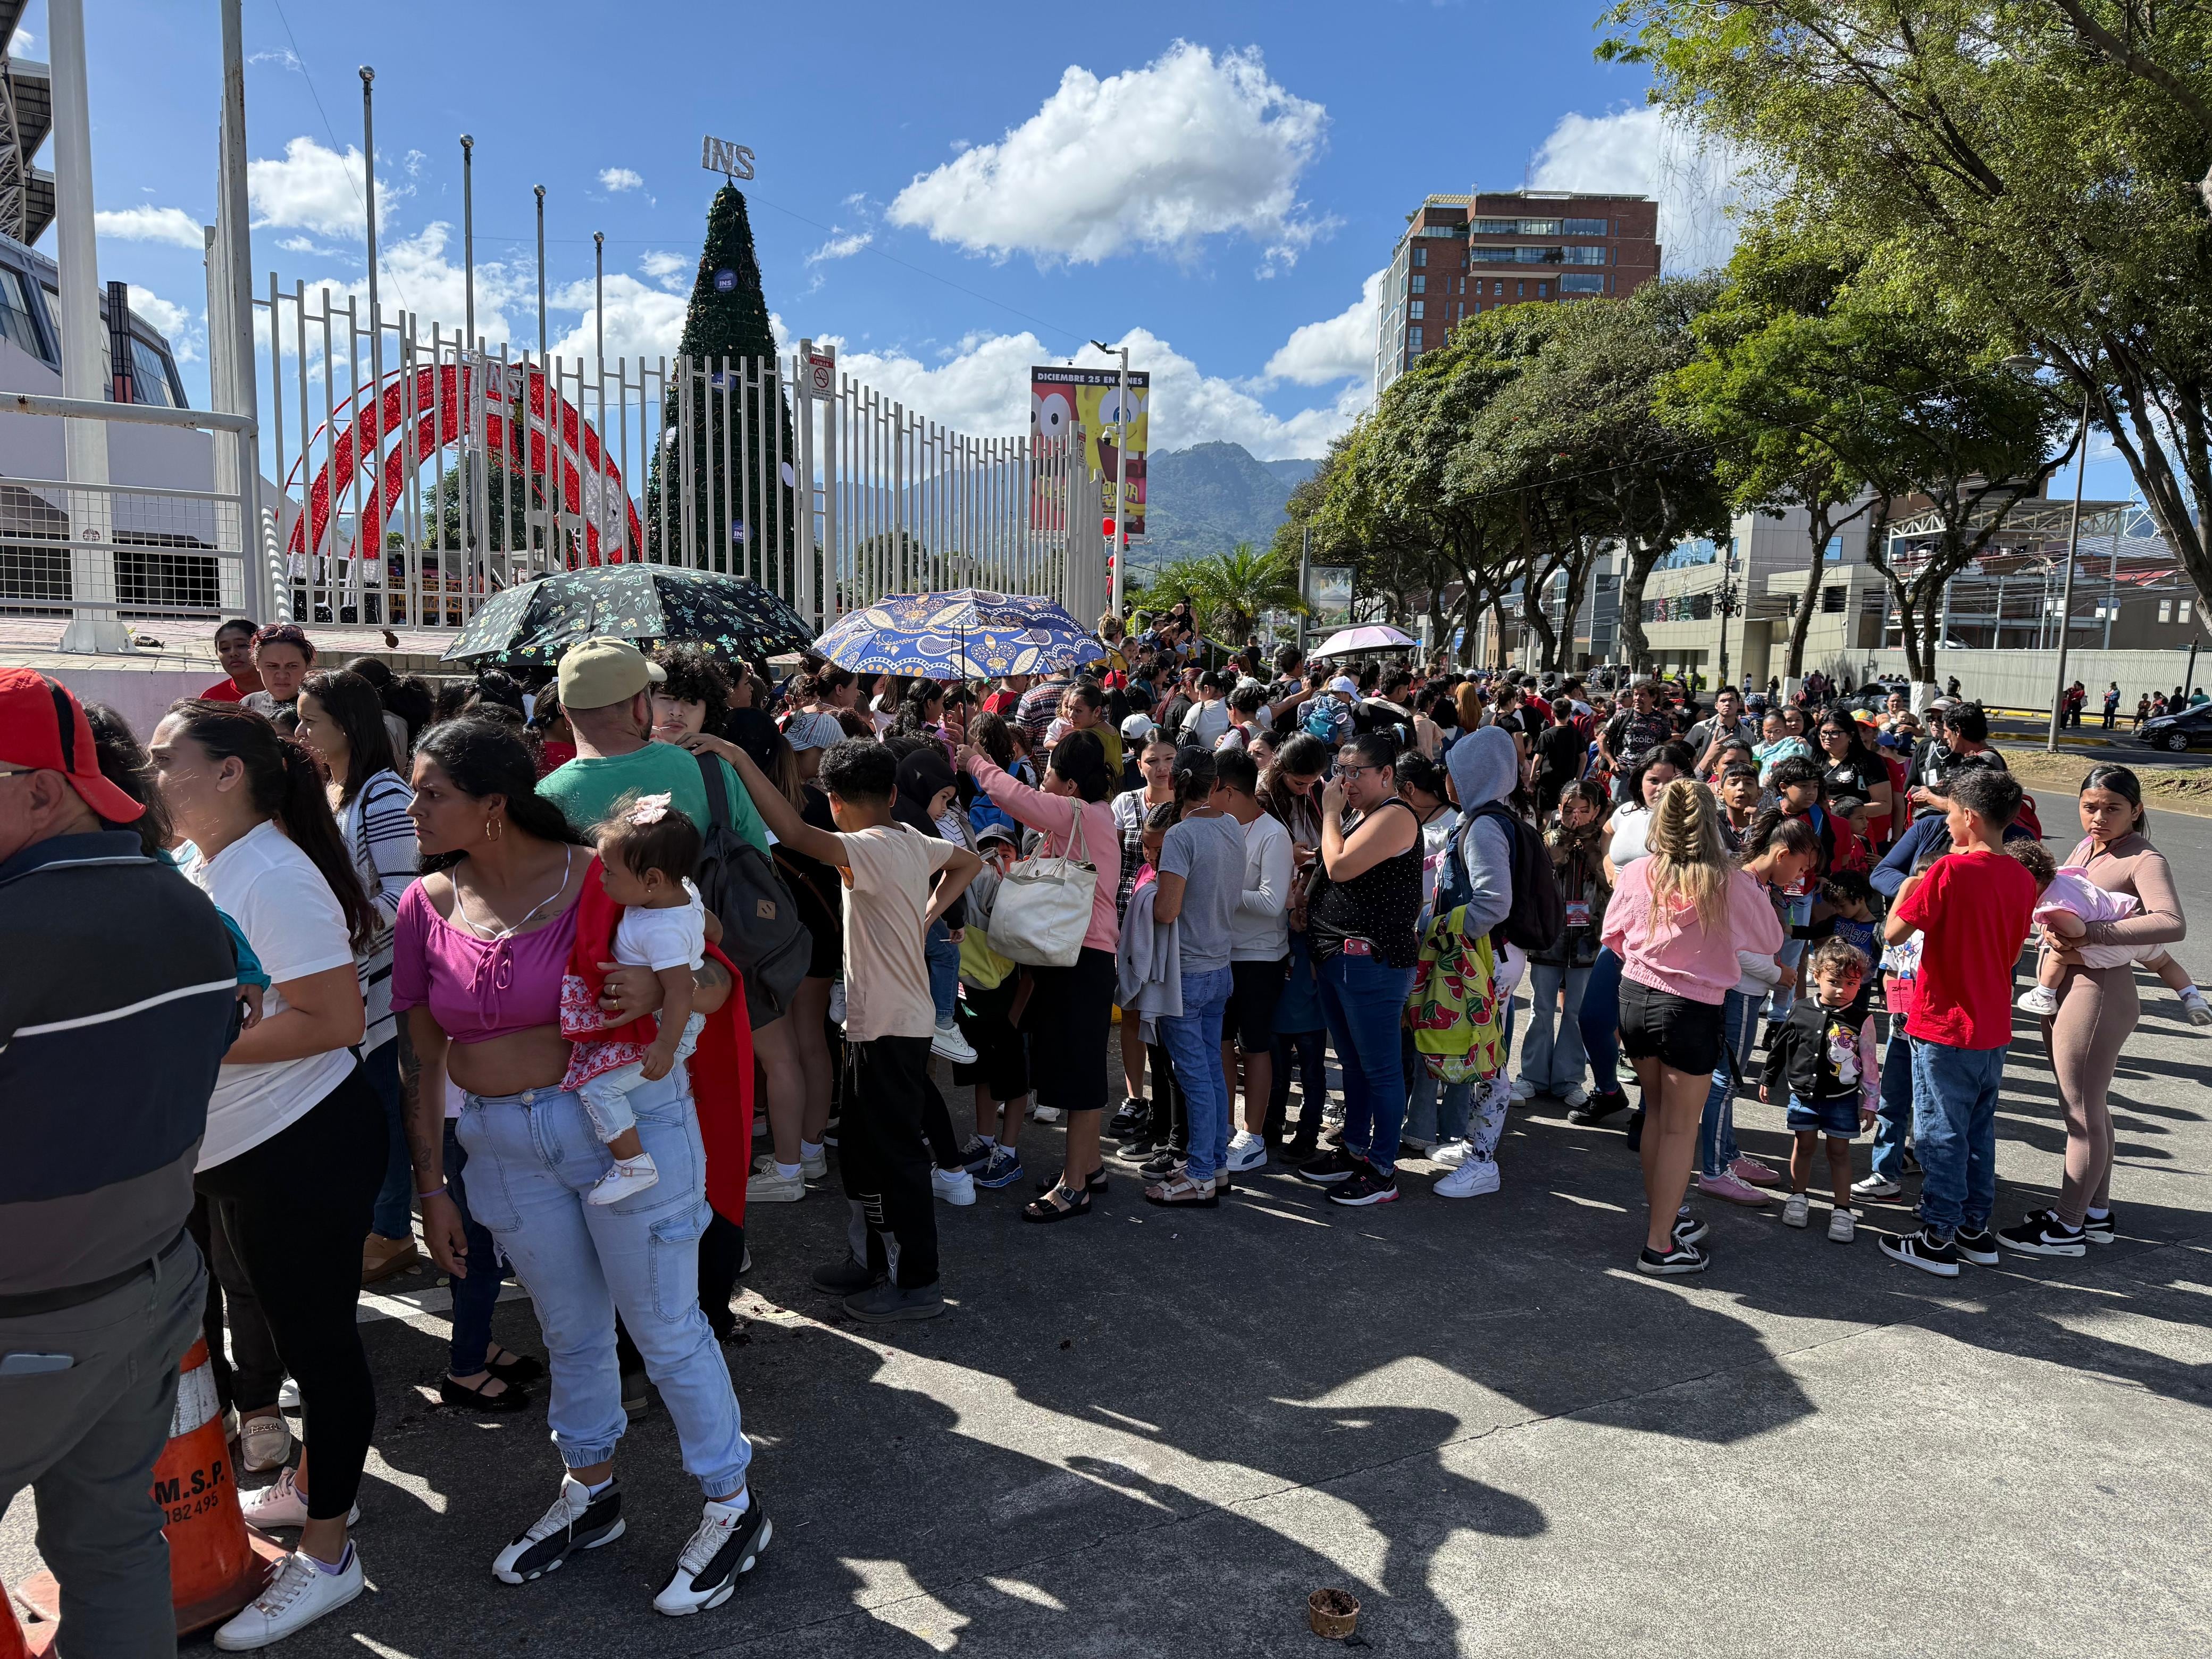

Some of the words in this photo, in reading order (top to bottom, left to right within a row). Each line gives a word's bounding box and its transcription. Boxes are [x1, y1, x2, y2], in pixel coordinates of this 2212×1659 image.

[702, 134, 755, 180] INS
[1037, 373, 1085, 382] DICIEMBRE
[1633, 734, 1656, 744] kölbi
